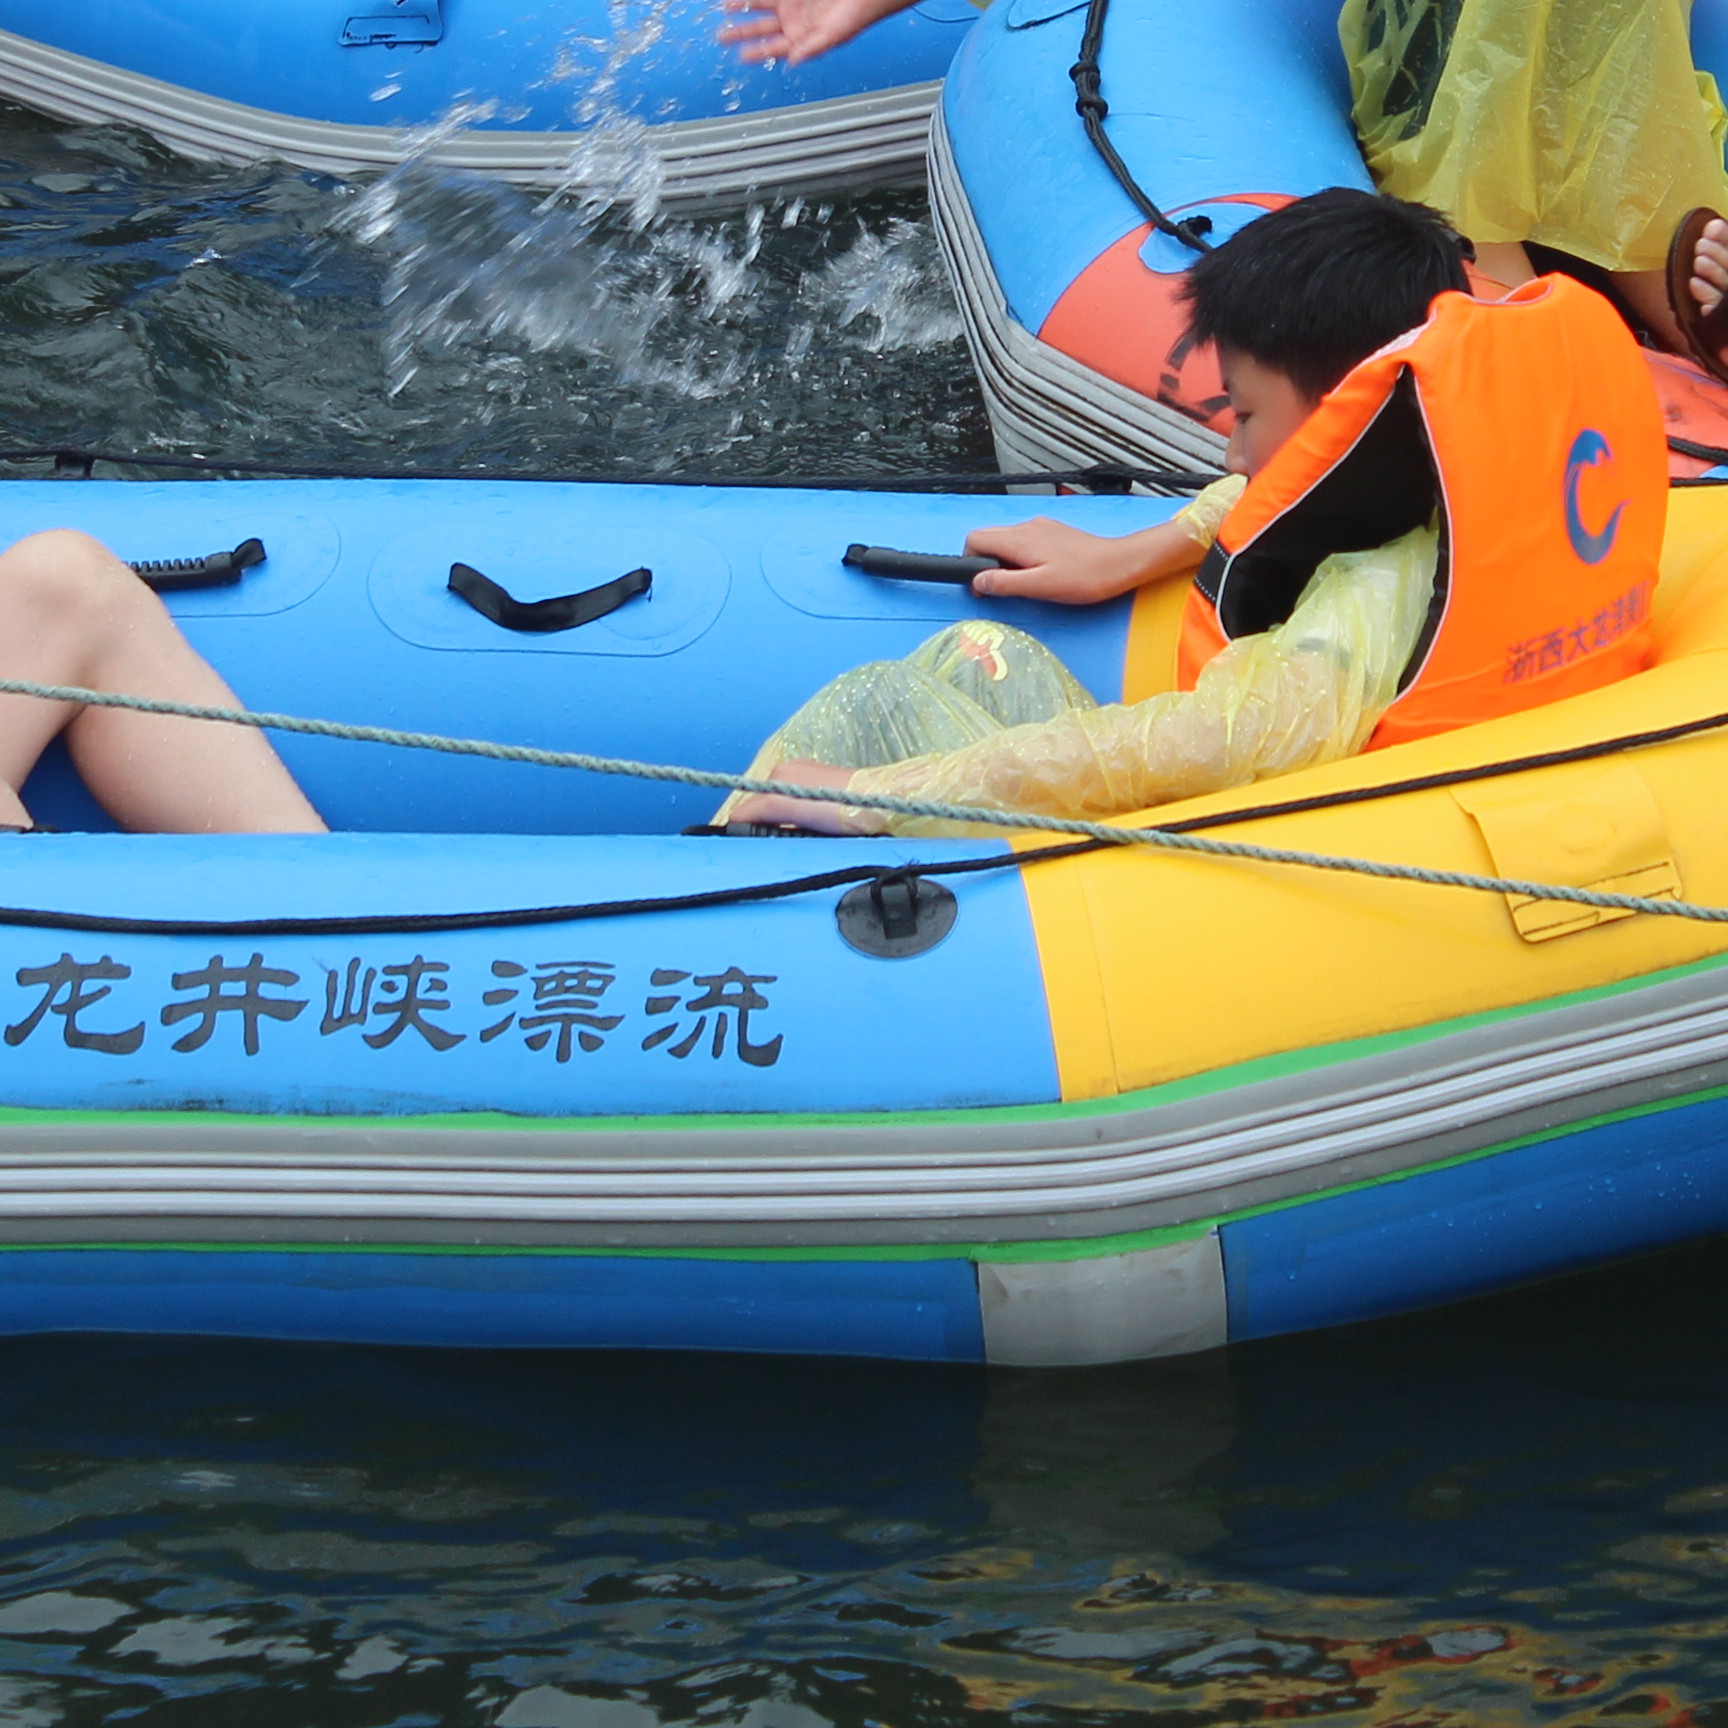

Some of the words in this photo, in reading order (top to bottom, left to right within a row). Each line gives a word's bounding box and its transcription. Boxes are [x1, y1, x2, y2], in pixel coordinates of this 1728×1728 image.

[4, 953, 783, 1067] 龙井峡漂流
